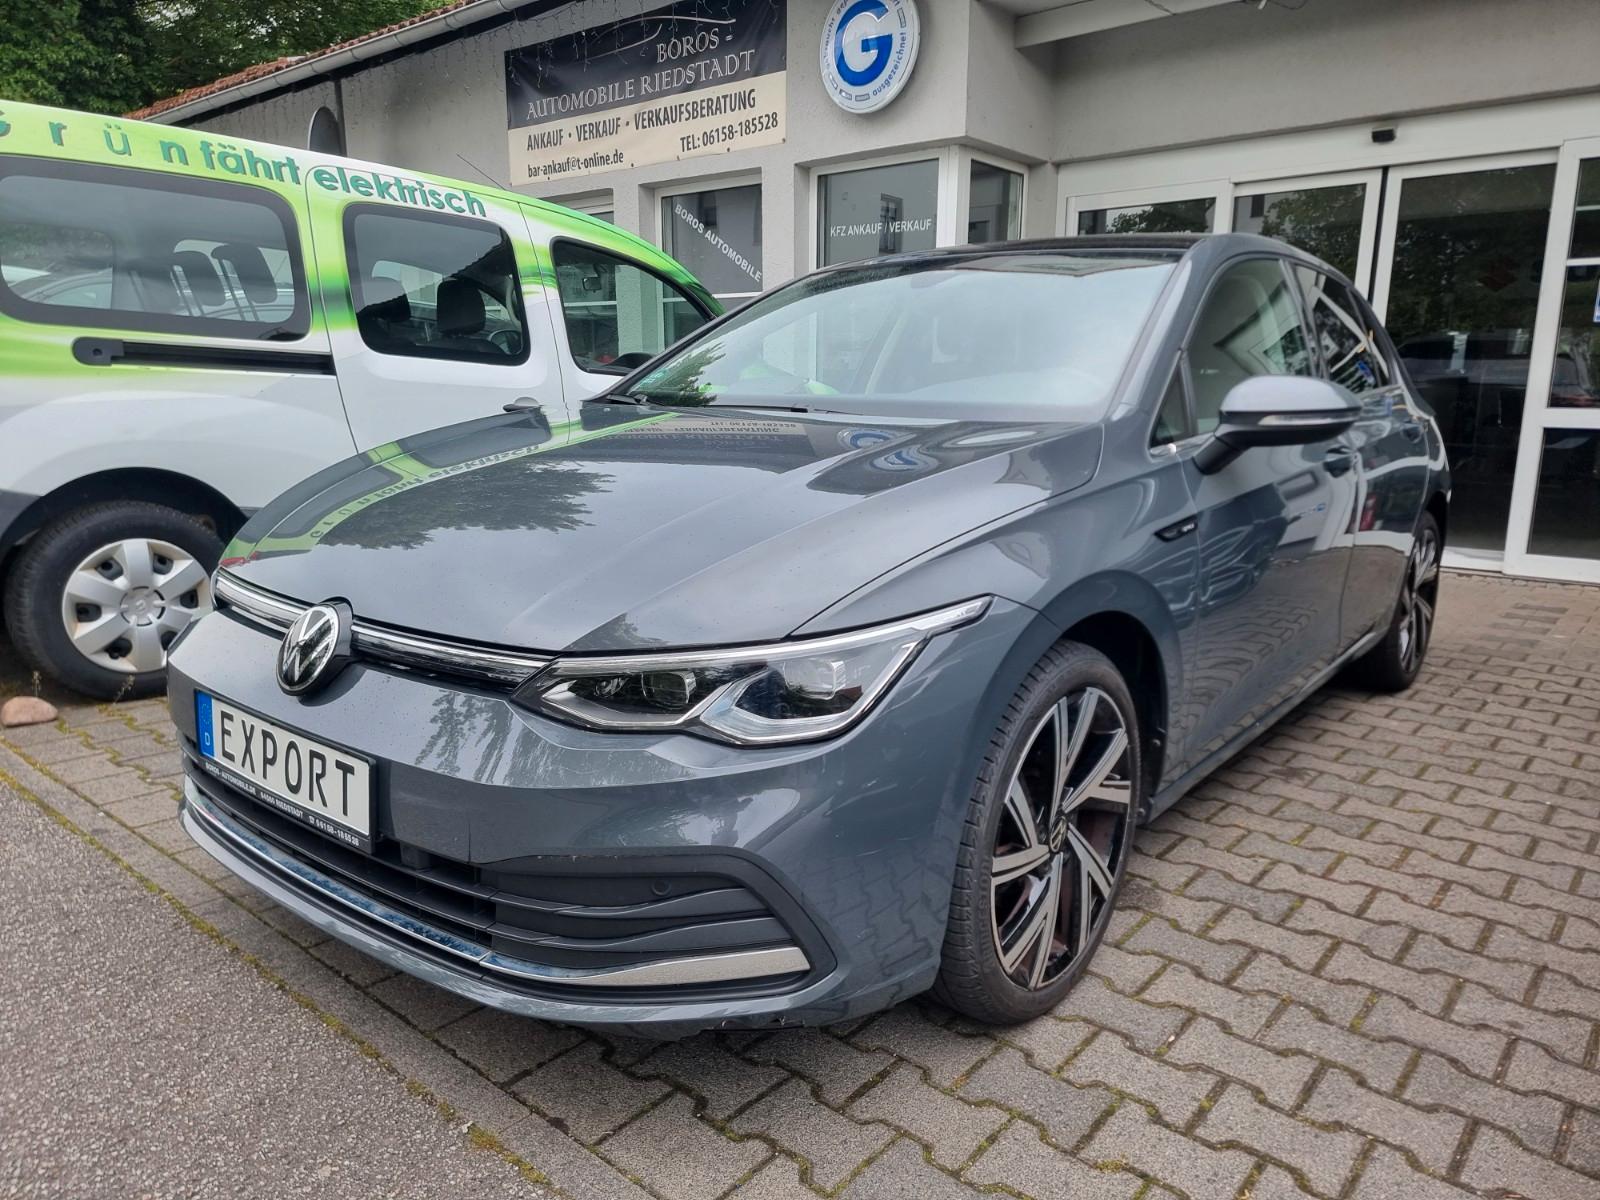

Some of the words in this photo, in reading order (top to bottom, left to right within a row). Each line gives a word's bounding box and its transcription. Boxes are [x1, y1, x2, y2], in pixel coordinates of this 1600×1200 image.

[656, 28, 720, 64] BOROS
[834, 0, 893, 87] G
[526, 79, 635, 121] AUTOMOBILE
[640, 49, 755, 95] RIEDSTADT
[526, 128, 564, 151] ANKAUF
[576, 117, 622, 142] VERKAUF
[634, 88, 757, 130] VERKAUFSBERATUNG
[680, 134, 701, 153] TEL:
[702, 111, 779, 148] 06158-185528
[200, 140, 301, 185] fährt
[313, 166, 487, 218] elektrisch
[527, 149, 625, 178] bar-ankauf@t-online.de
[674, 203, 705, 235] BOROS
[704, 230, 763, 283] AUTOMOBILE
[830, 225, 846, 238] KFZ
[847, 221, 883, 236] ANKAUF
[889, 218, 933, 233] VERKAUF
[204, 732, 211, 746] D
[220, 709, 356, 817] EXPORT
